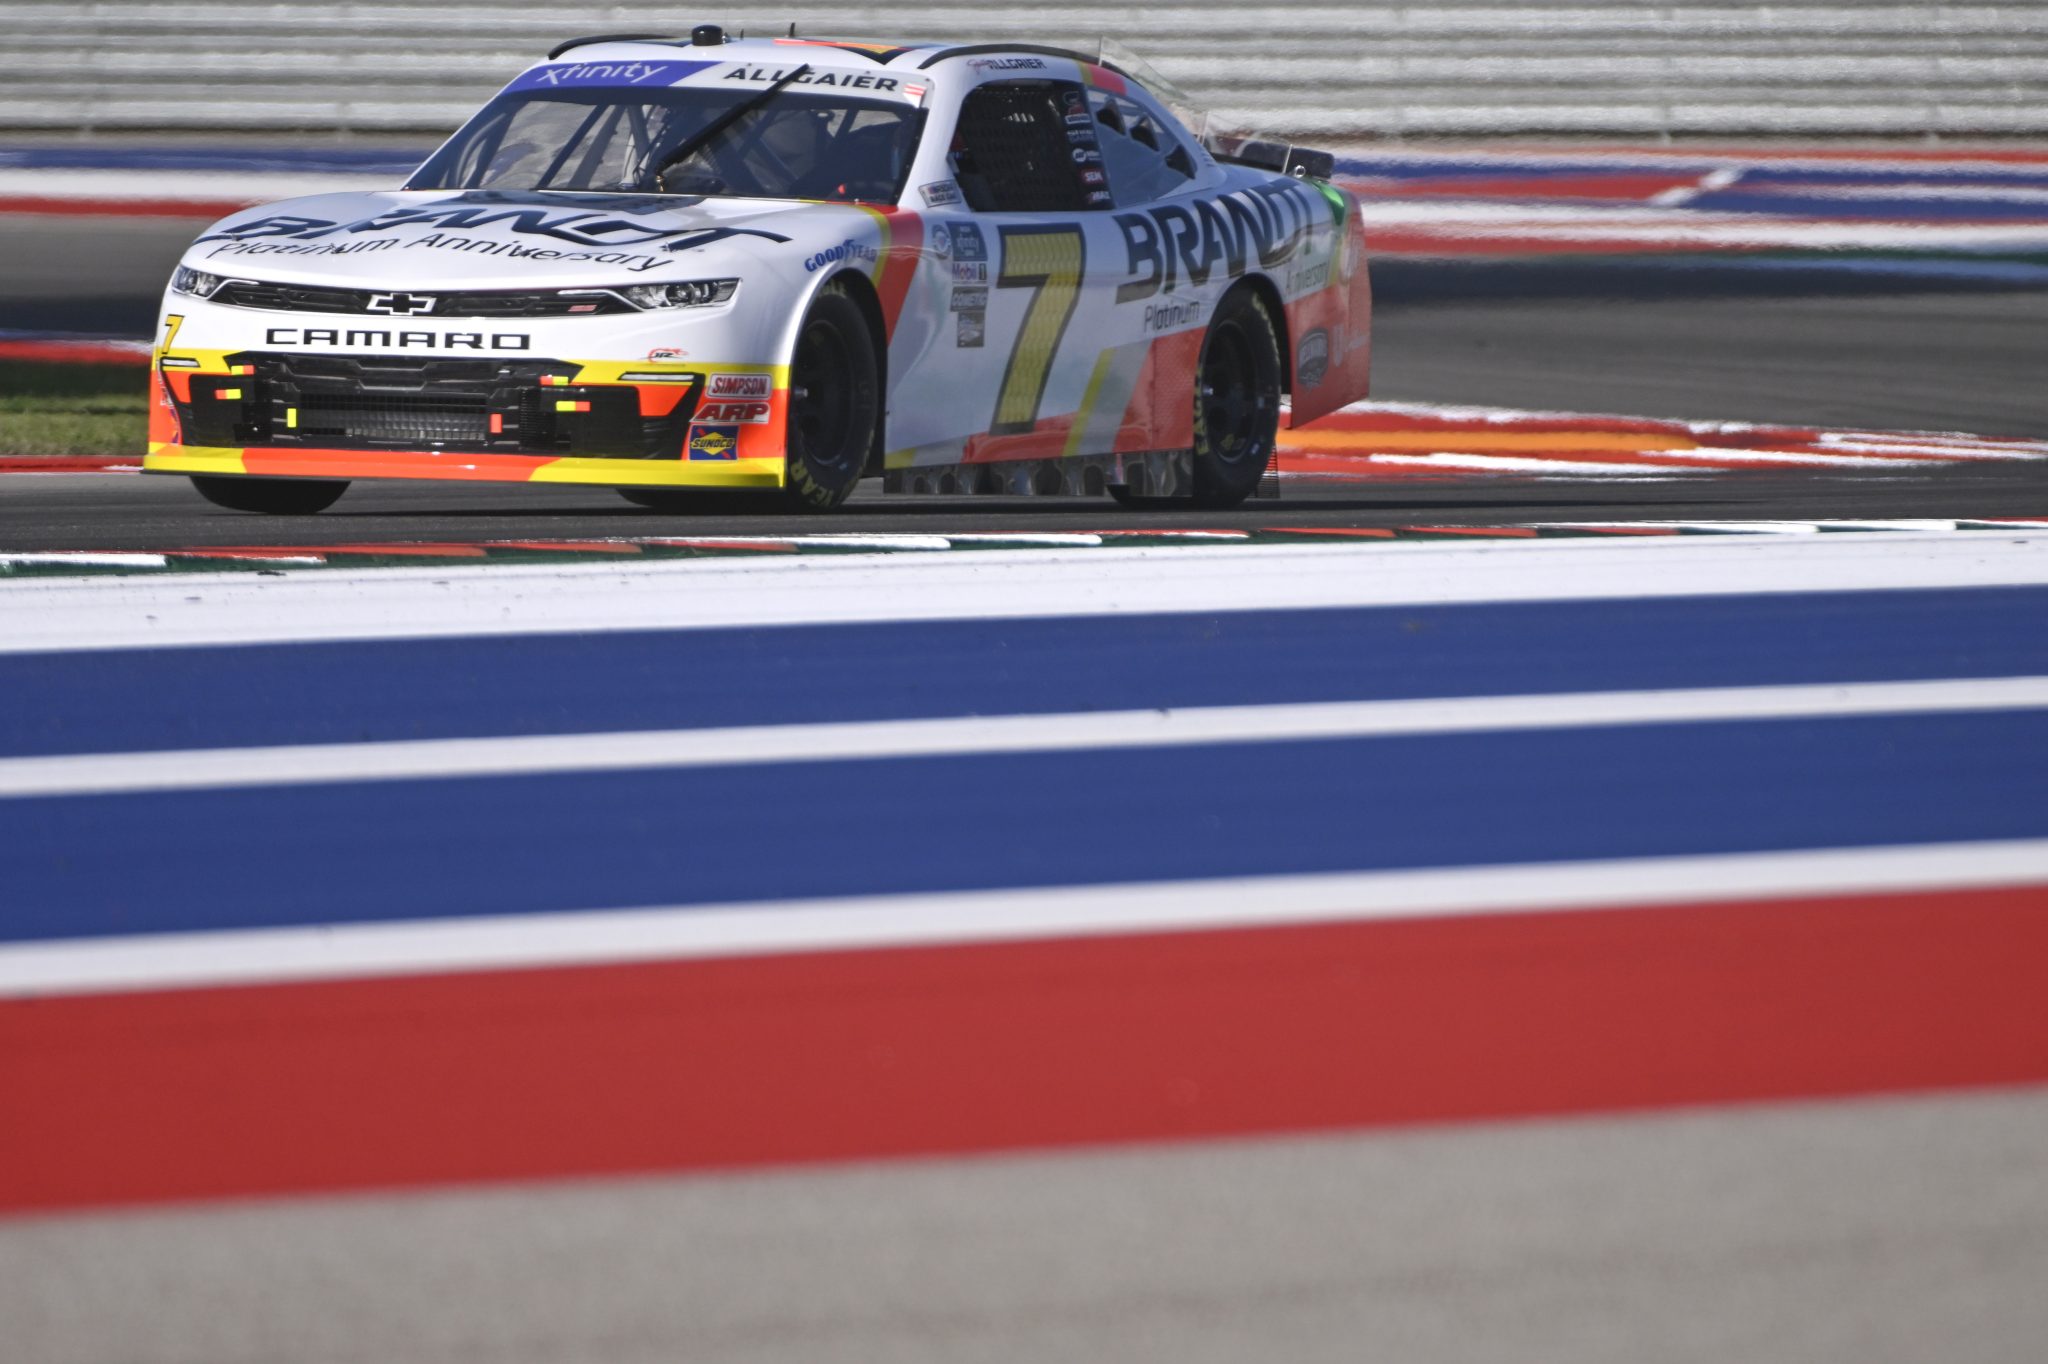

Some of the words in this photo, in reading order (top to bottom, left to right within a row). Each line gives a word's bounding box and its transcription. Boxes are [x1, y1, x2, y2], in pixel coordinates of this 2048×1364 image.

[536, 62, 669, 85] xfinity
[206, 238, 400, 259] Platinum
[402, 233, 674, 272] Anniversary
[1144, 300, 1200, 332] Platinum
[162, 314, 185, 354] 7
[266, 328, 530, 350] CAMARO
[989, 222, 1087, 436] 7
[712, 376, 768, 394] SIMPSON
[693, 403, 769, 422] ARP
[692, 438, 735, 448] SUNOCO
